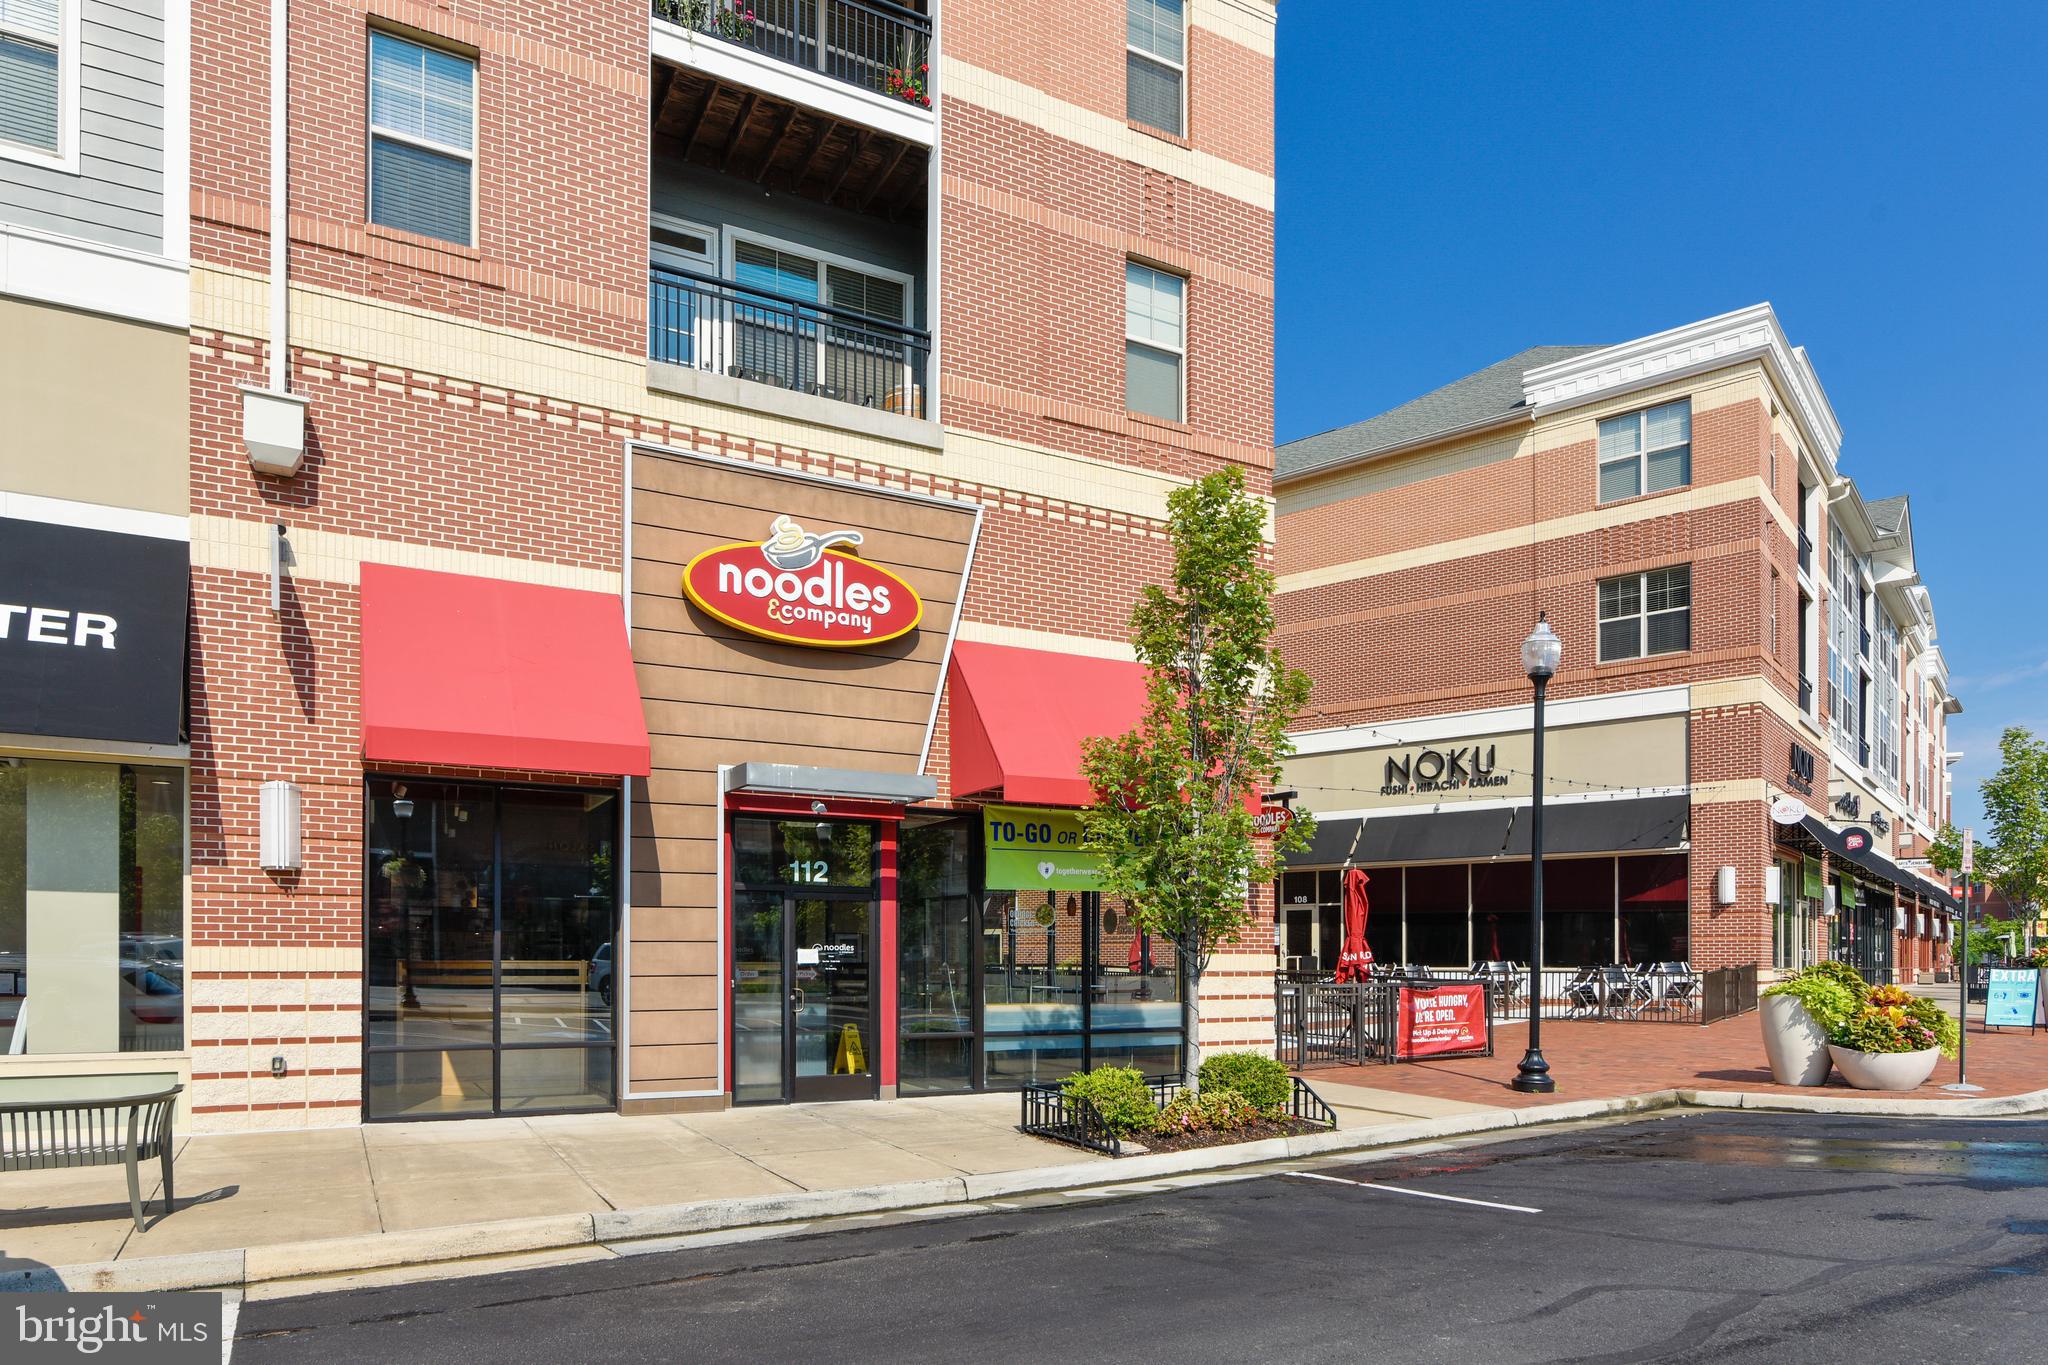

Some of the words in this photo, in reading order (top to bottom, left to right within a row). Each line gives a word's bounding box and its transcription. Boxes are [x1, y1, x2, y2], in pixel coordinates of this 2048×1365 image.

[719, 559, 891, 614] noodles
[0, 604, 118, 650] TER
[1385, 745, 1496, 783] NOKU
[1416, 780, 1460, 793] HIBACHI
[1469, 776, 1508, 788] RAMEN
[1252, 811, 1286, 827] OODLES
[990, 822, 1051, 843] TO-GO
[1057, 831, 1077, 844] OR
[789, 860, 829, 882] 112
[1294, 896, 1308, 904] 108
[1992, 969, 2036, 982] EXTRA
[1439, 994, 1468, 1007] HUNGRY,
[1437, 1028, 1460, 1036] Delivery
